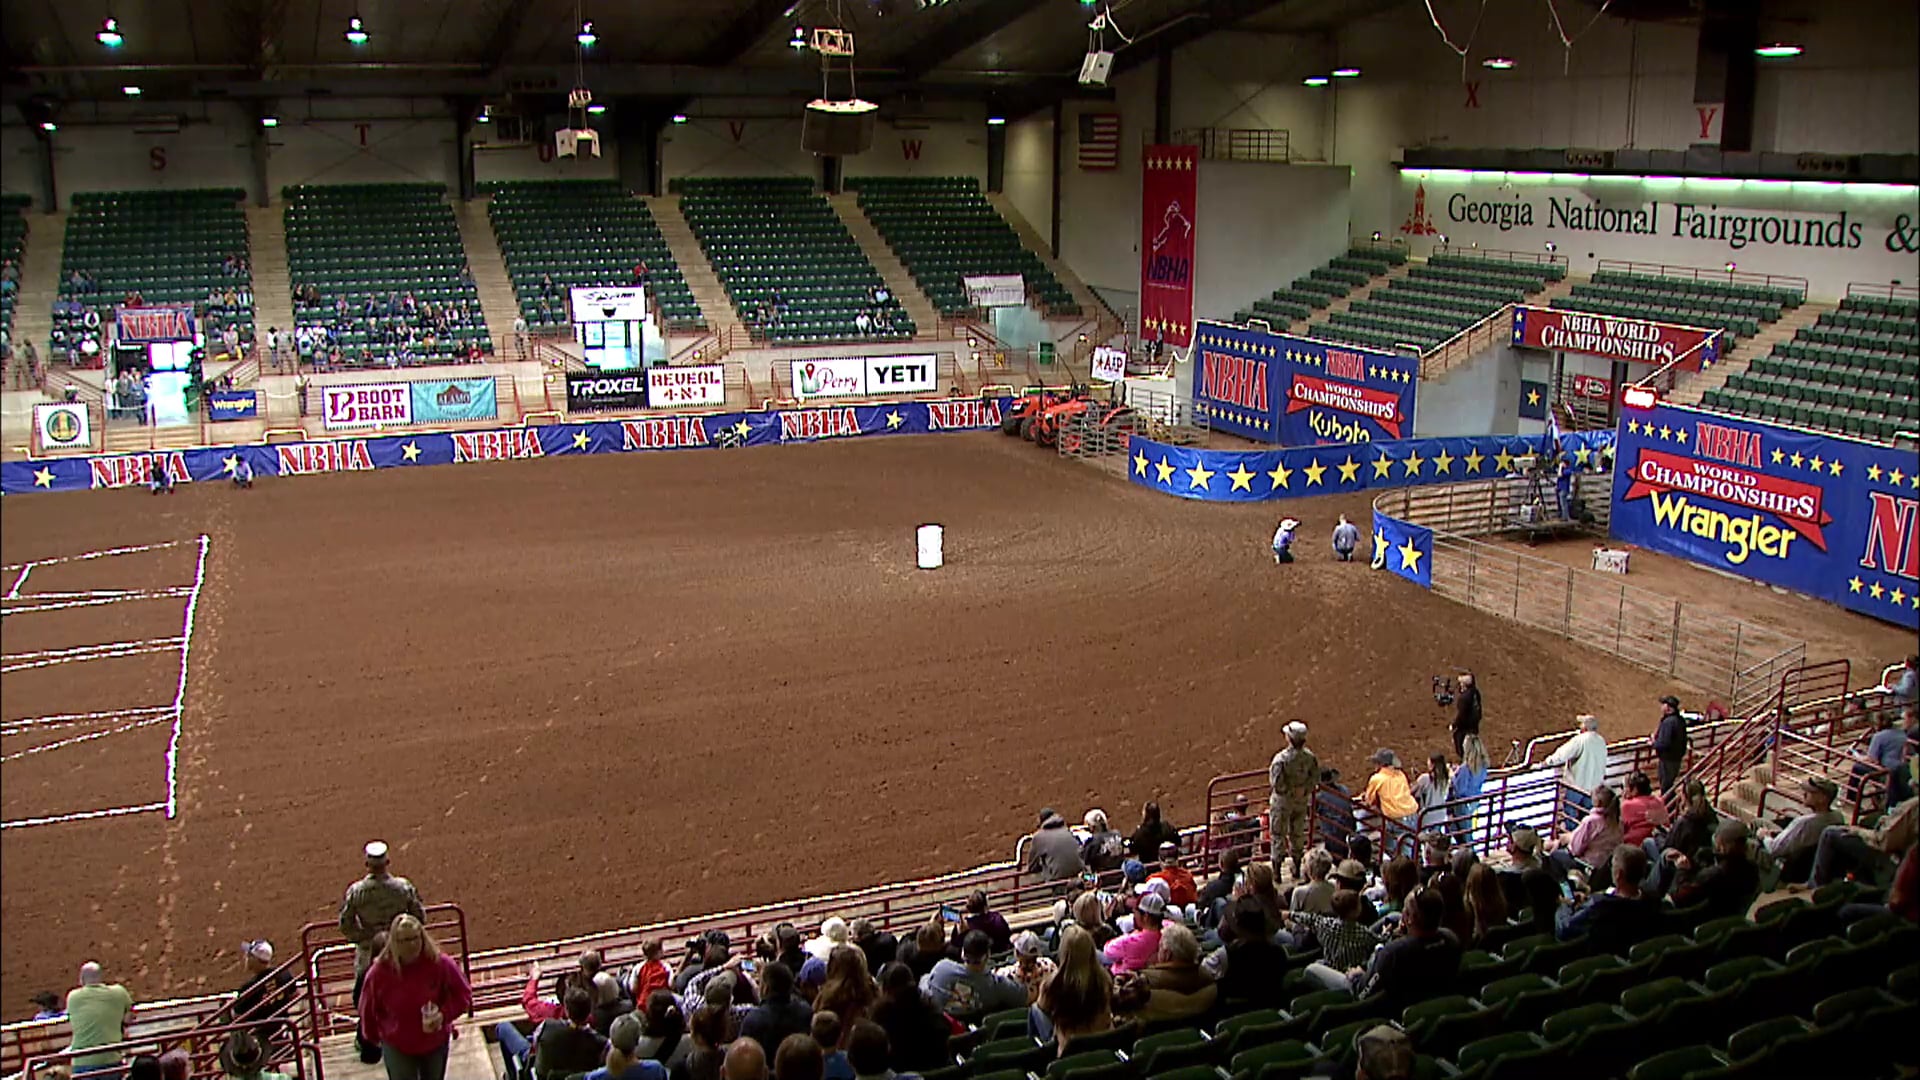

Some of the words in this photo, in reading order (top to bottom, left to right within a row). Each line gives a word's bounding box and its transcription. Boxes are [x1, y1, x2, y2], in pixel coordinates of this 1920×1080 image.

[354, 123, 371, 146] T
[729, 121, 744, 143] V
[1696, 107, 1717, 138] Y
[150, 147, 166, 170] S
[902, 139, 922, 160] W
[1447, 194, 1533, 230] Georgia
[1547, 197, 1658, 236] National
[1672, 203, 1862, 250] Fairgrounds
[1885, 213, 1917, 252] &
[1147, 255, 1188, 283] NBHA
[119, 312, 192, 340] NBHA
[1561, 315, 1602, 335] NBHA
[1604, 320, 1660, 343] WORLD
[1541, 324, 1675, 365] CHAMPIONSHIPS
[651, 370, 721, 387] REVEAL
[874, 364, 927, 385] YETI
[1325, 349, 1365, 381] NBHA
[570, 377, 644, 397] TROXEL
[816, 367, 858, 393] Perry
[1200, 350, 1269, 412] NBHA
[1324, 382, 1362, 399] WORLD
[212, 398, 255, 412] Wrangler
[358, 388, 404, 404] BOOT
[1294, 383, 1395, 420] CHAMPIONSHIPS
[359, 404, 405, 421] BARN
[780, 408, 861, 440] NBHA
[928, 400, 1002, 430] NBHA
[451, 428, 544, 463] NBHA
[620, 418, 709, 451] NBHA
[1693, 421, 1762, 468] NBHA
[275, 440, 375, 476] NBHA
[1692, 462, 1757, 487] WORLD
[1640, 460, 1815, 518] CHAMPIONSHIPS
[1650, 490, 1796, 564] Wrangler
